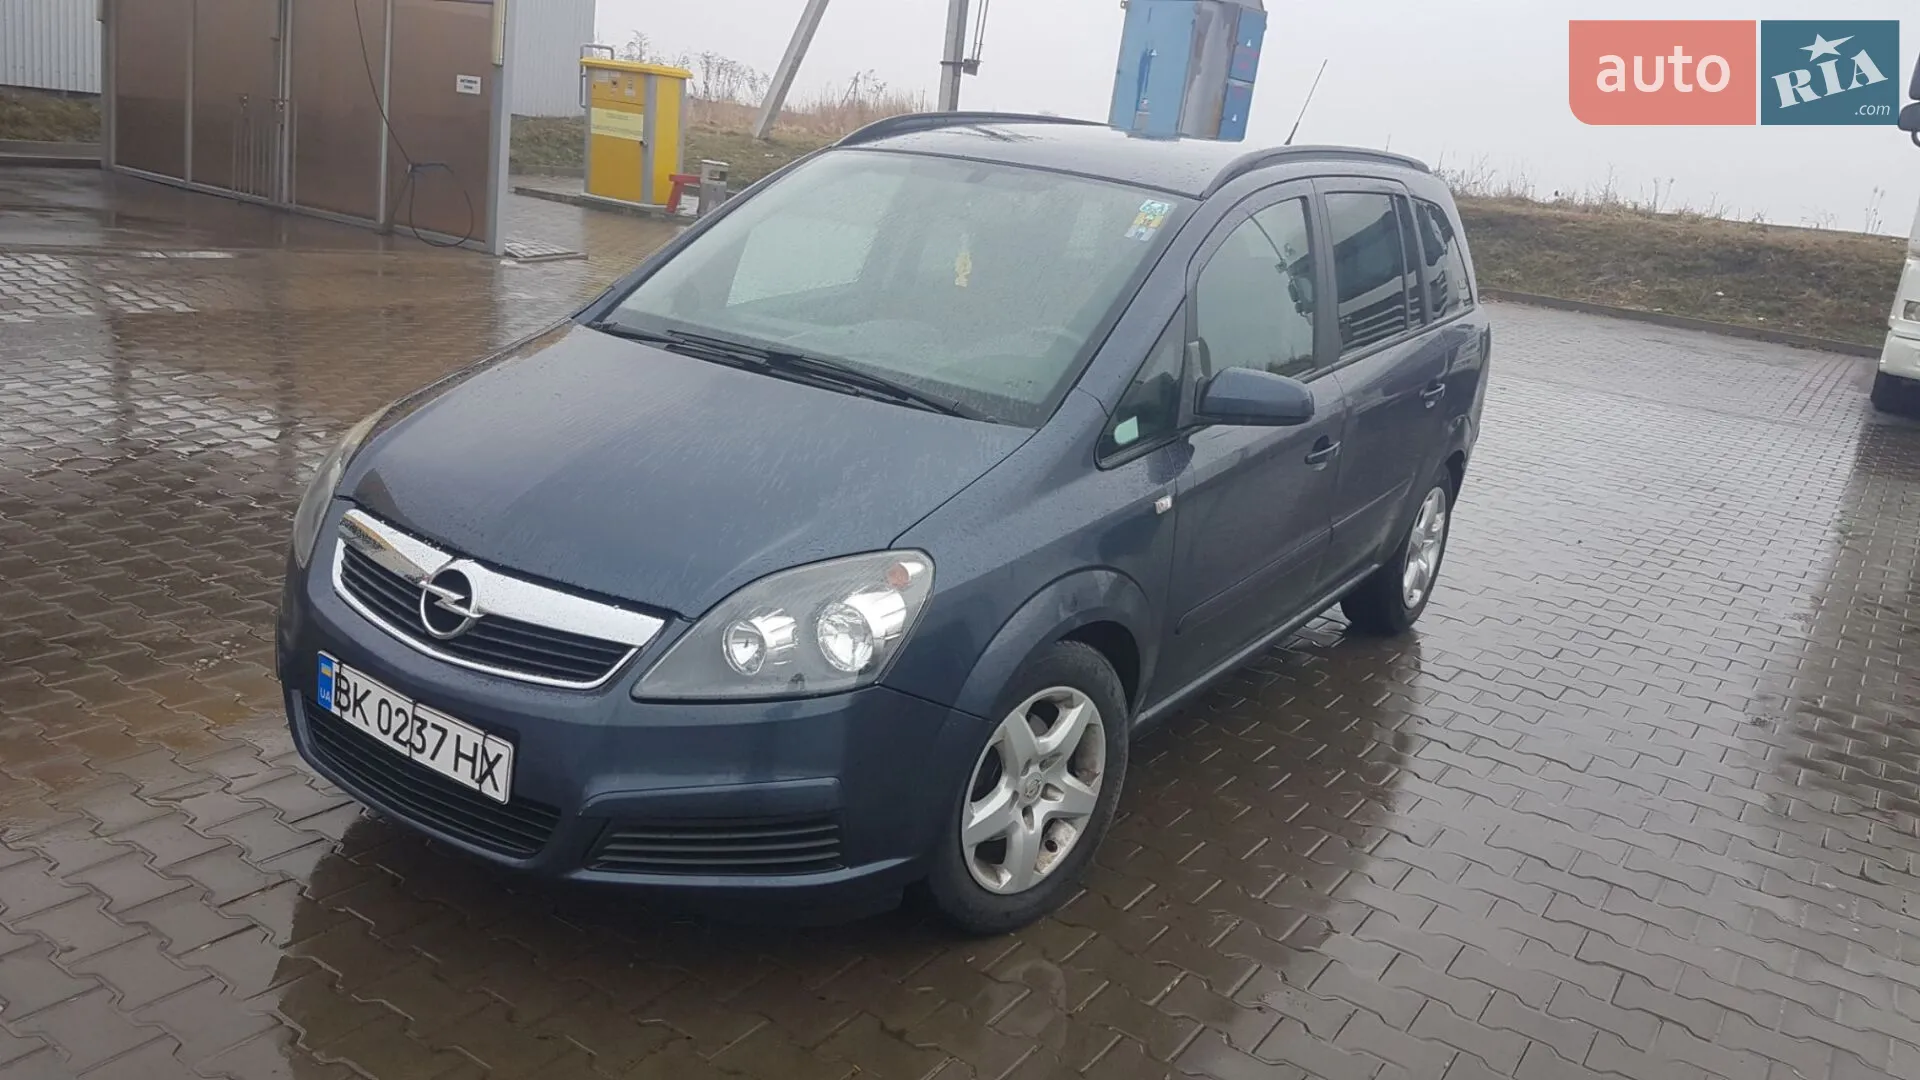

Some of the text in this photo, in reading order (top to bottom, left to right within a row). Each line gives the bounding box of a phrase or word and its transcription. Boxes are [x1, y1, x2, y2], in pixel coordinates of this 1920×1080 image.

[320, 689, 331, 702] UA
[334, 672, 503, 792] BK 0237 HX
